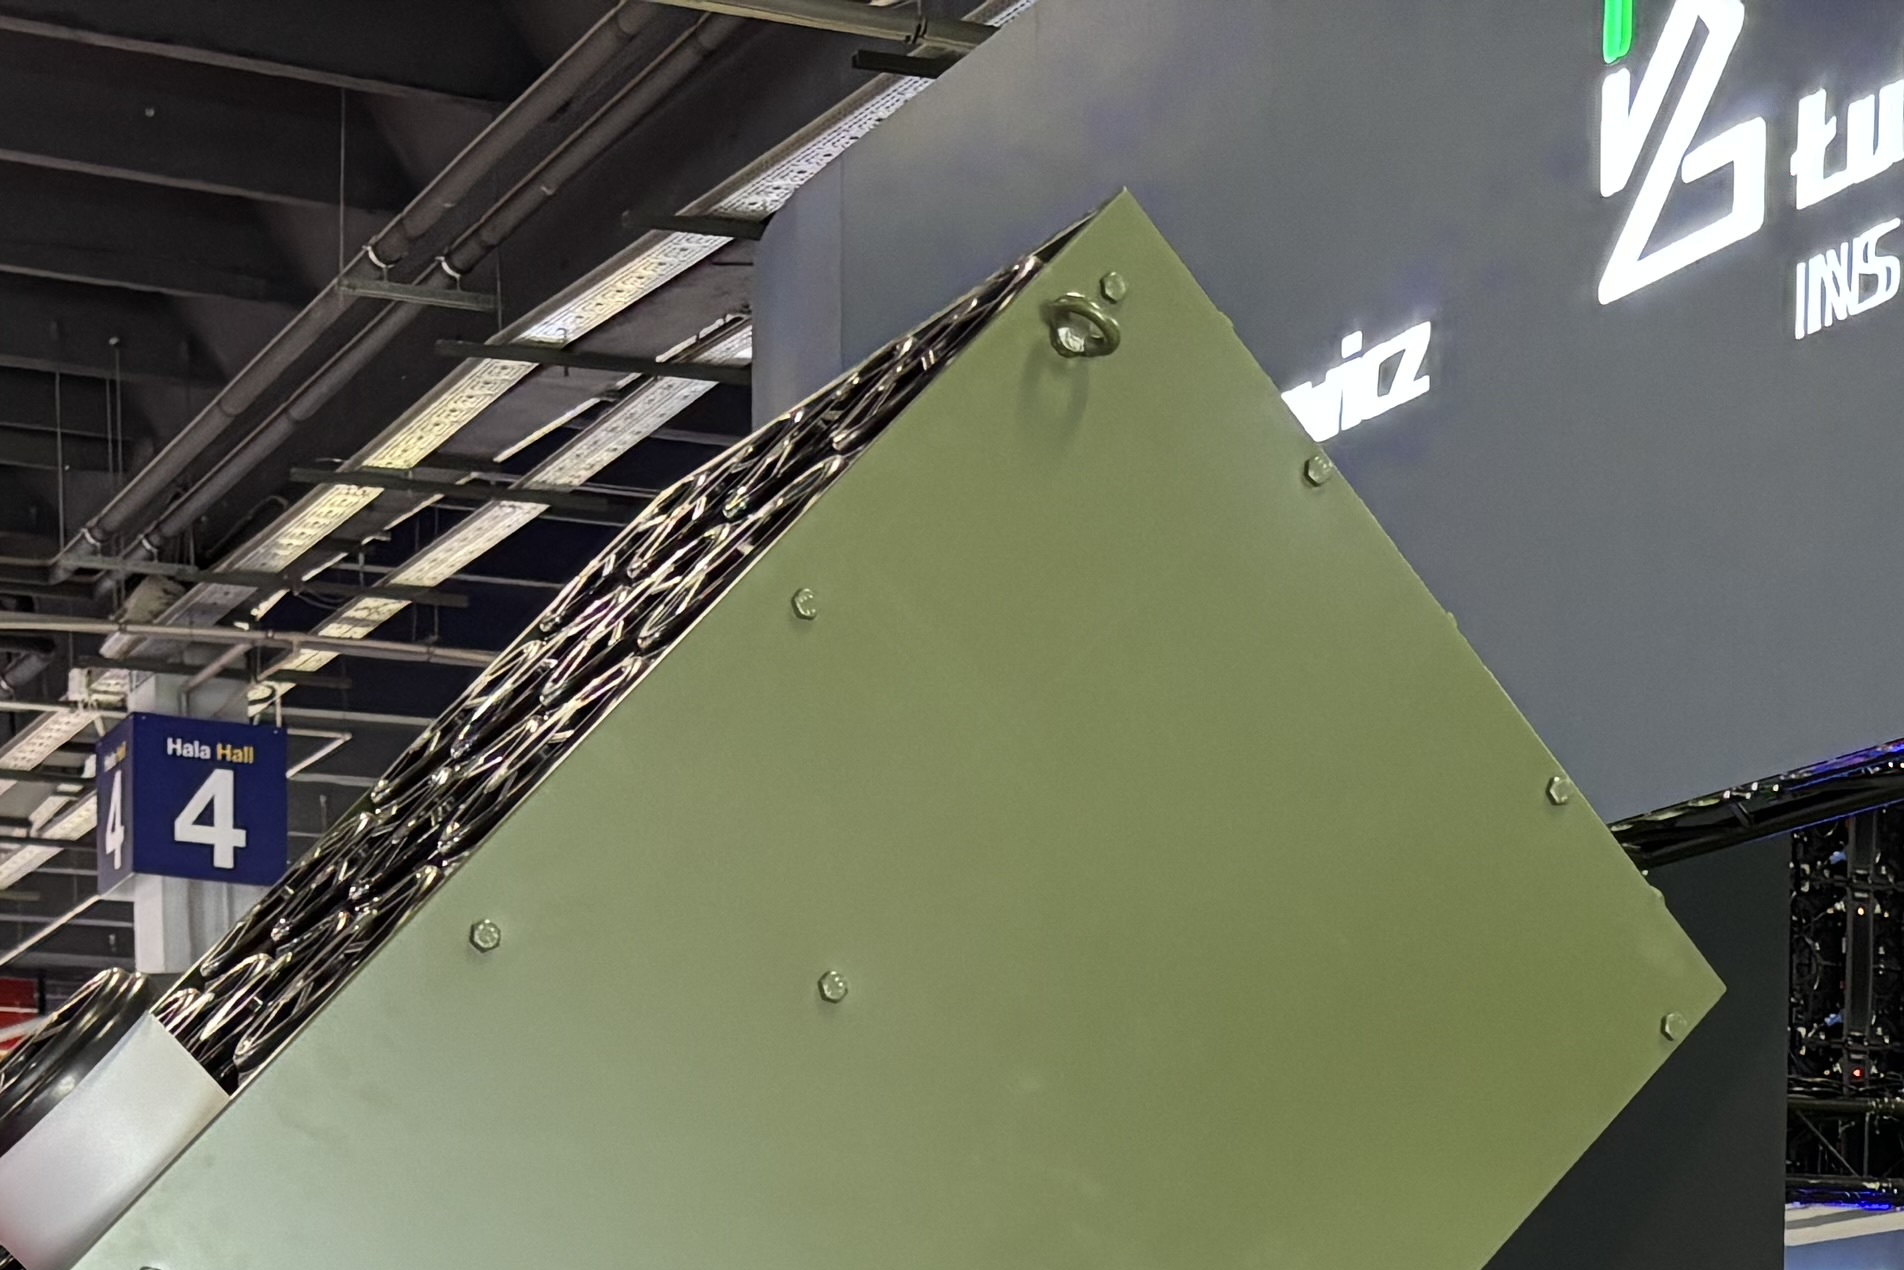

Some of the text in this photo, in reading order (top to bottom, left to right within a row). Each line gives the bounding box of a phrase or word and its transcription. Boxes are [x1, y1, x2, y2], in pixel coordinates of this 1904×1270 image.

[167, 737, 254, 763] Hala Hall
[106, 770, 124, 870] 4
[174, 769, 246, 869] 4
